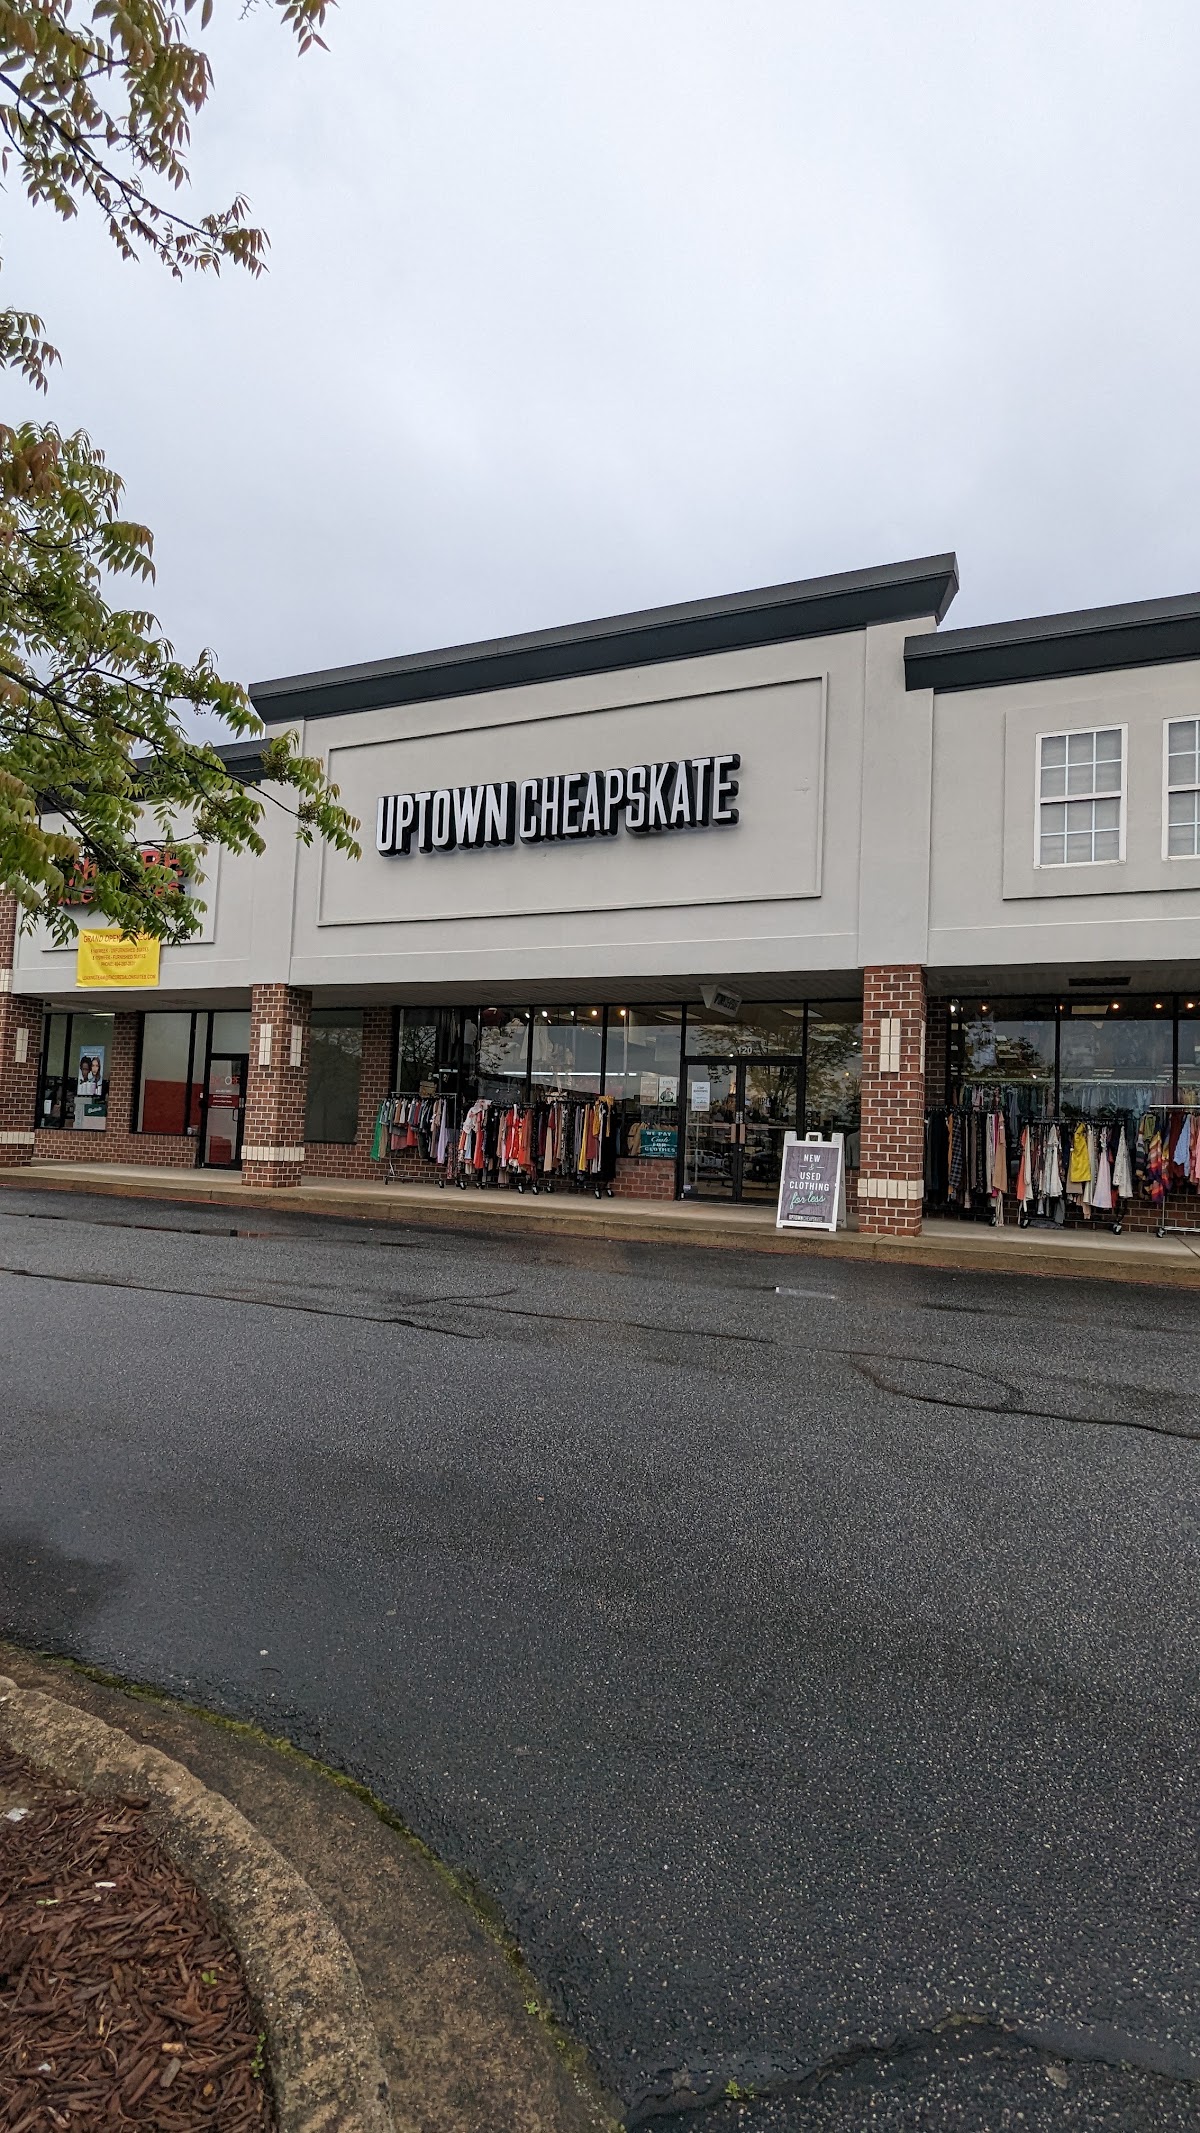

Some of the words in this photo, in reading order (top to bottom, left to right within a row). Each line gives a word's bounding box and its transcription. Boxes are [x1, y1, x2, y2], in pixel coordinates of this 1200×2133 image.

[375, 781, 515, 856] UPTOWN
[519, 754, 740, 844] CHEAPSKATE
[83, 935, 103, 943] GRAND
[737, 1046, 753, 1054] 120
[803, 1154, 820, 1162] NEW
[800, 1172, 820, 1180] USED
[789, 1181, 829, 1191] CLOTHING
[790, 1192, 806, 1209] for
[807, 1191, 826, 1203] less
